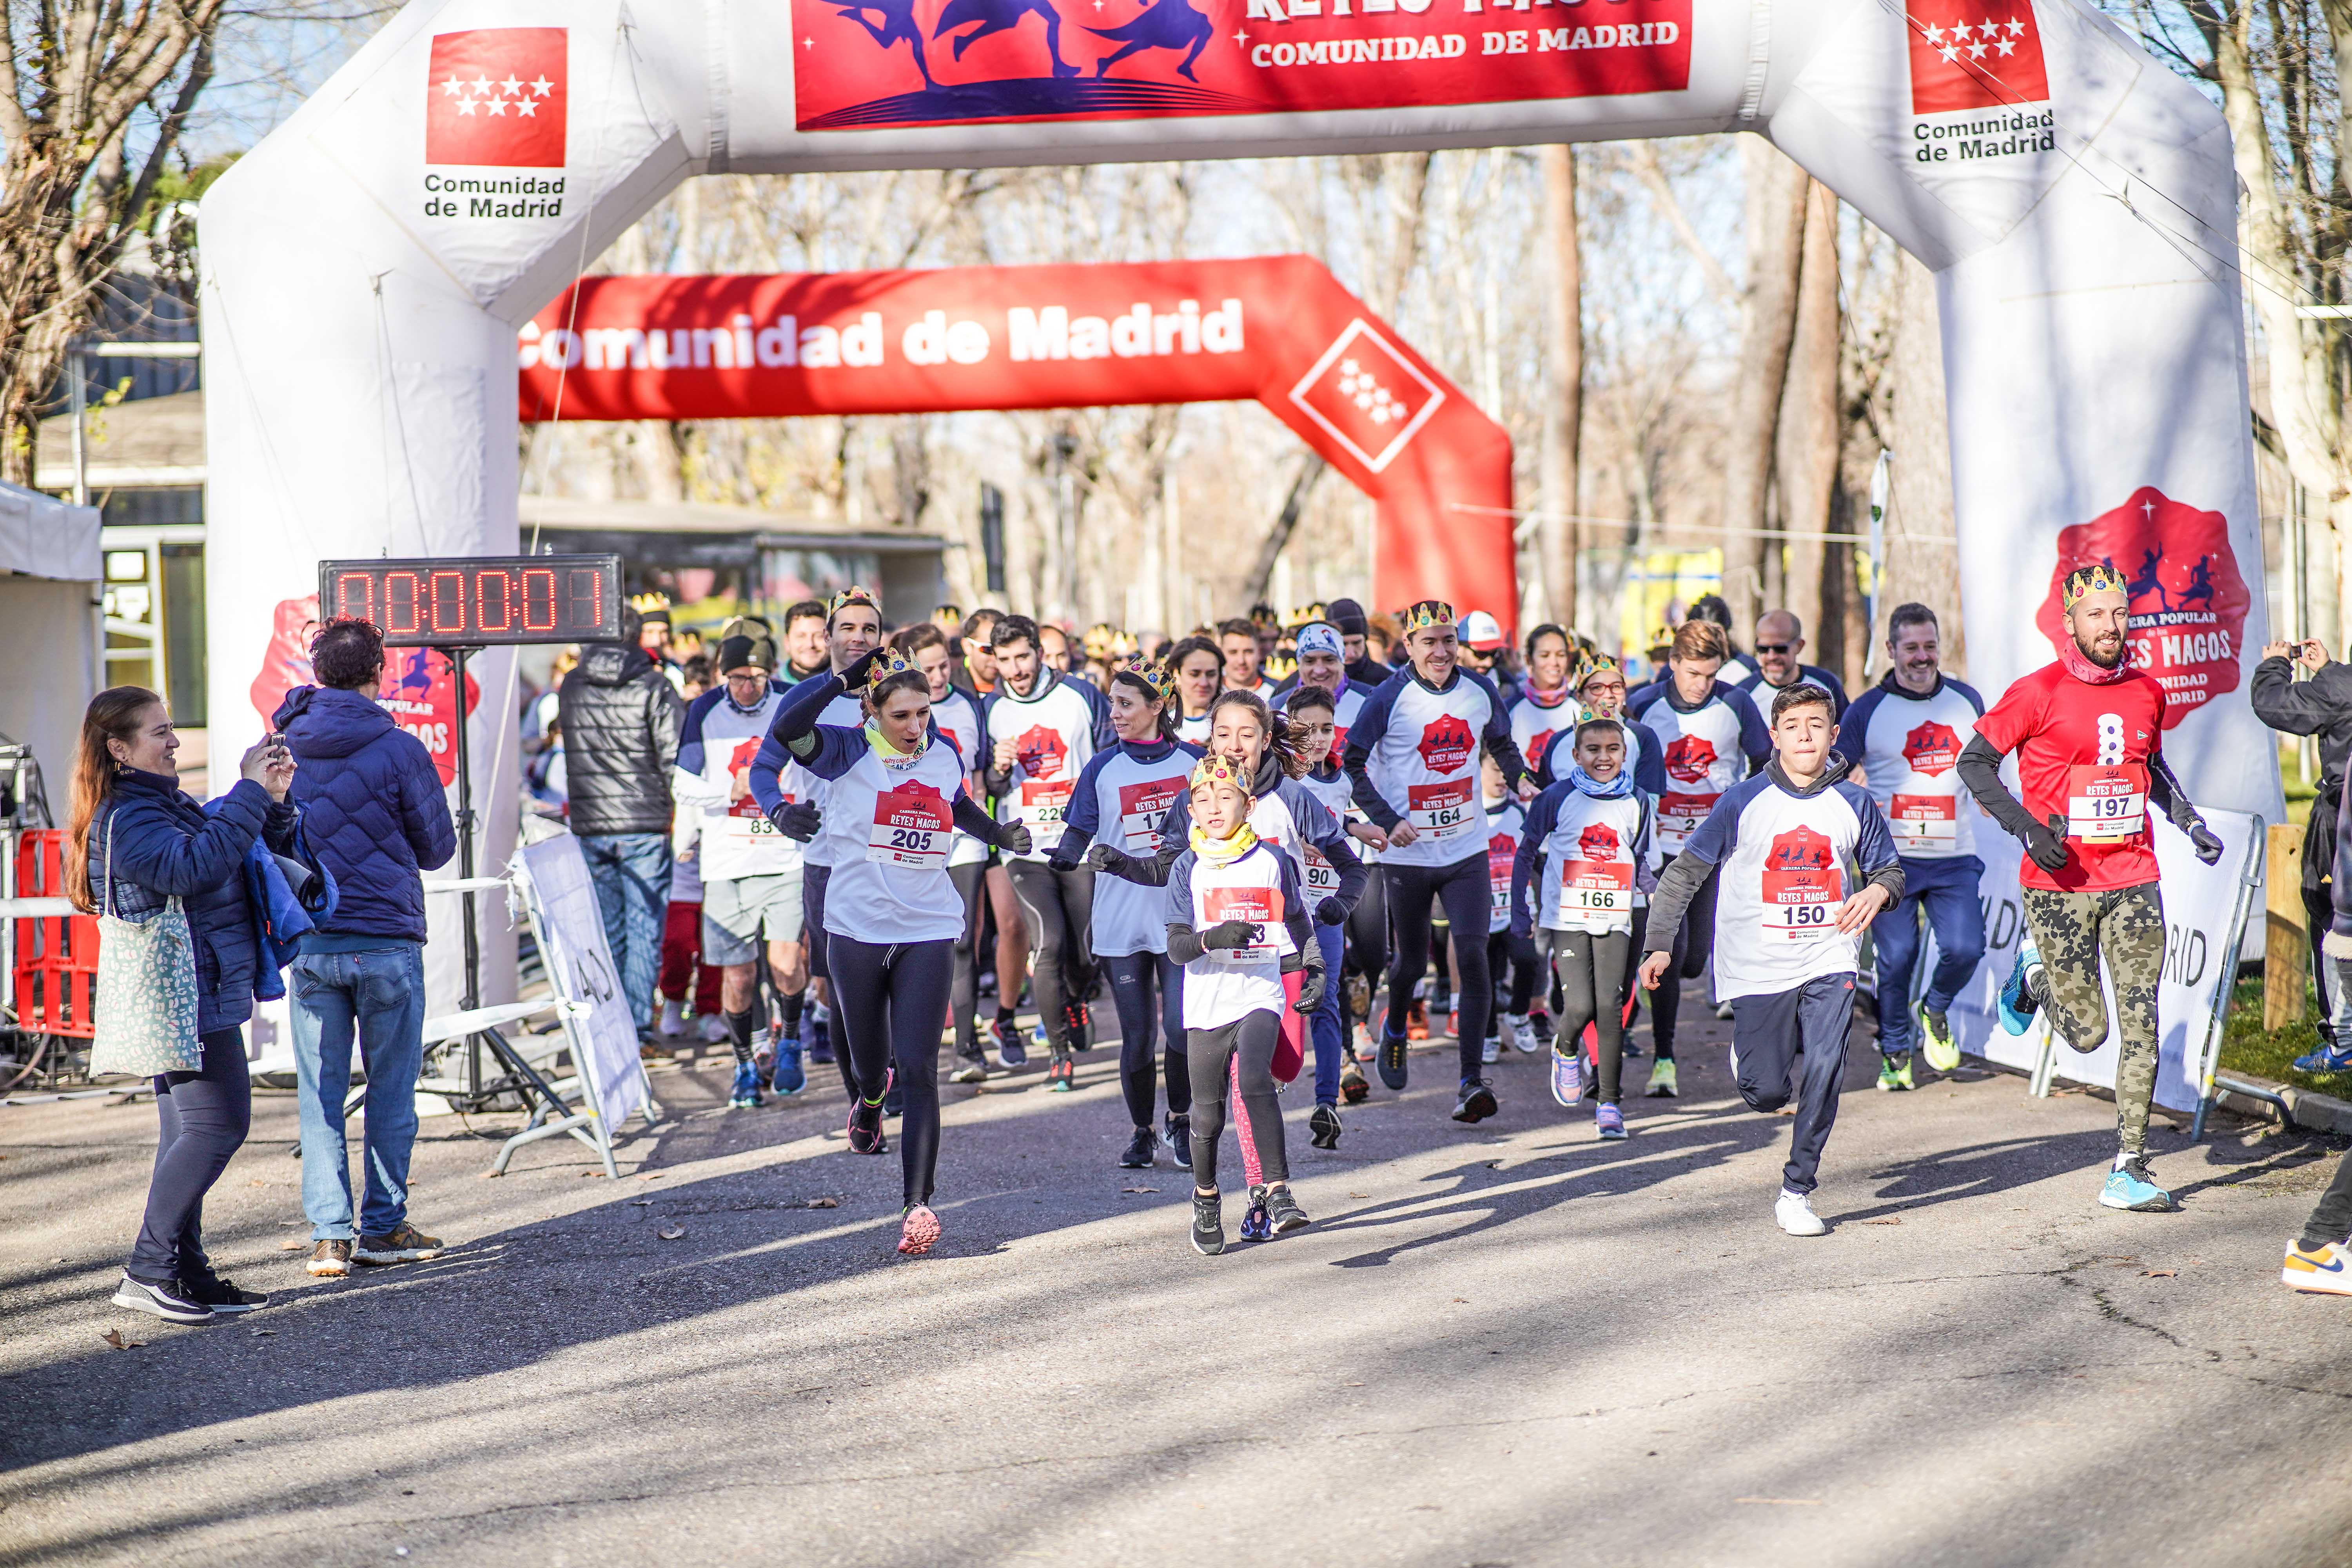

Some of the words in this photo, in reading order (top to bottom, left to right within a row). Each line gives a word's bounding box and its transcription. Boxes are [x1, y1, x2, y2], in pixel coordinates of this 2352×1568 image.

[1251, 34, 1467, 67] COMUNIDAD
[1482, 30, 1528, 55] DE
[1537, 22, 1679, 52] MADRID
[1913, 108, 2054, 140] Comunidad
[1915, 143, 1948, 162] de
[1960, 130, 2055, 159] Madrid
[425, 174, 566, 194] Comunidad
[425, 197, 458, 217] de
[470, 198, 563, 218] Madrid
[903, 310, 990, 365] de
[1009, 299, 1244, 361] Madrid
[2159, 612, 2216, 625] POPULAR
[2146, 628, 2155, 637] de
[2157, 627, 2168, 636] los
[2160, 629, 2231, 668] MAGOS
[2086, 785, 2110, 795] REYES
[2112, 783, 2133, 795] MAGOS
[1135, 800, 1157, 812] REYES
[1158, 795, 1178, 808] MAG
[1423, 800, 1443, 809] REYES
[2092, 797, 2129, 816] 197
[890, 814, 914, 827] REYES
[916, 818, 940, 829] MAGOS
[1428, 808, 1461, 826] 164
[751, 821, 772, 833] 83
[1919, 822, 1926, 834] 1
[891, 829, 932, 850] 205
[1308, 868, 1328, 885] 90
[1581, 891, 1613, 907] 166
[1777, 893, 1801, 903] REYES
[1804, 891, 1829, 903] MAGOS
[1220, 909, 1245, 920] REYES
[1248, 909, 1269, 920] MAGOS
[1784, 906, 1825, 925] 150
[1296, 998, 1315, 1007] KIPSTA
